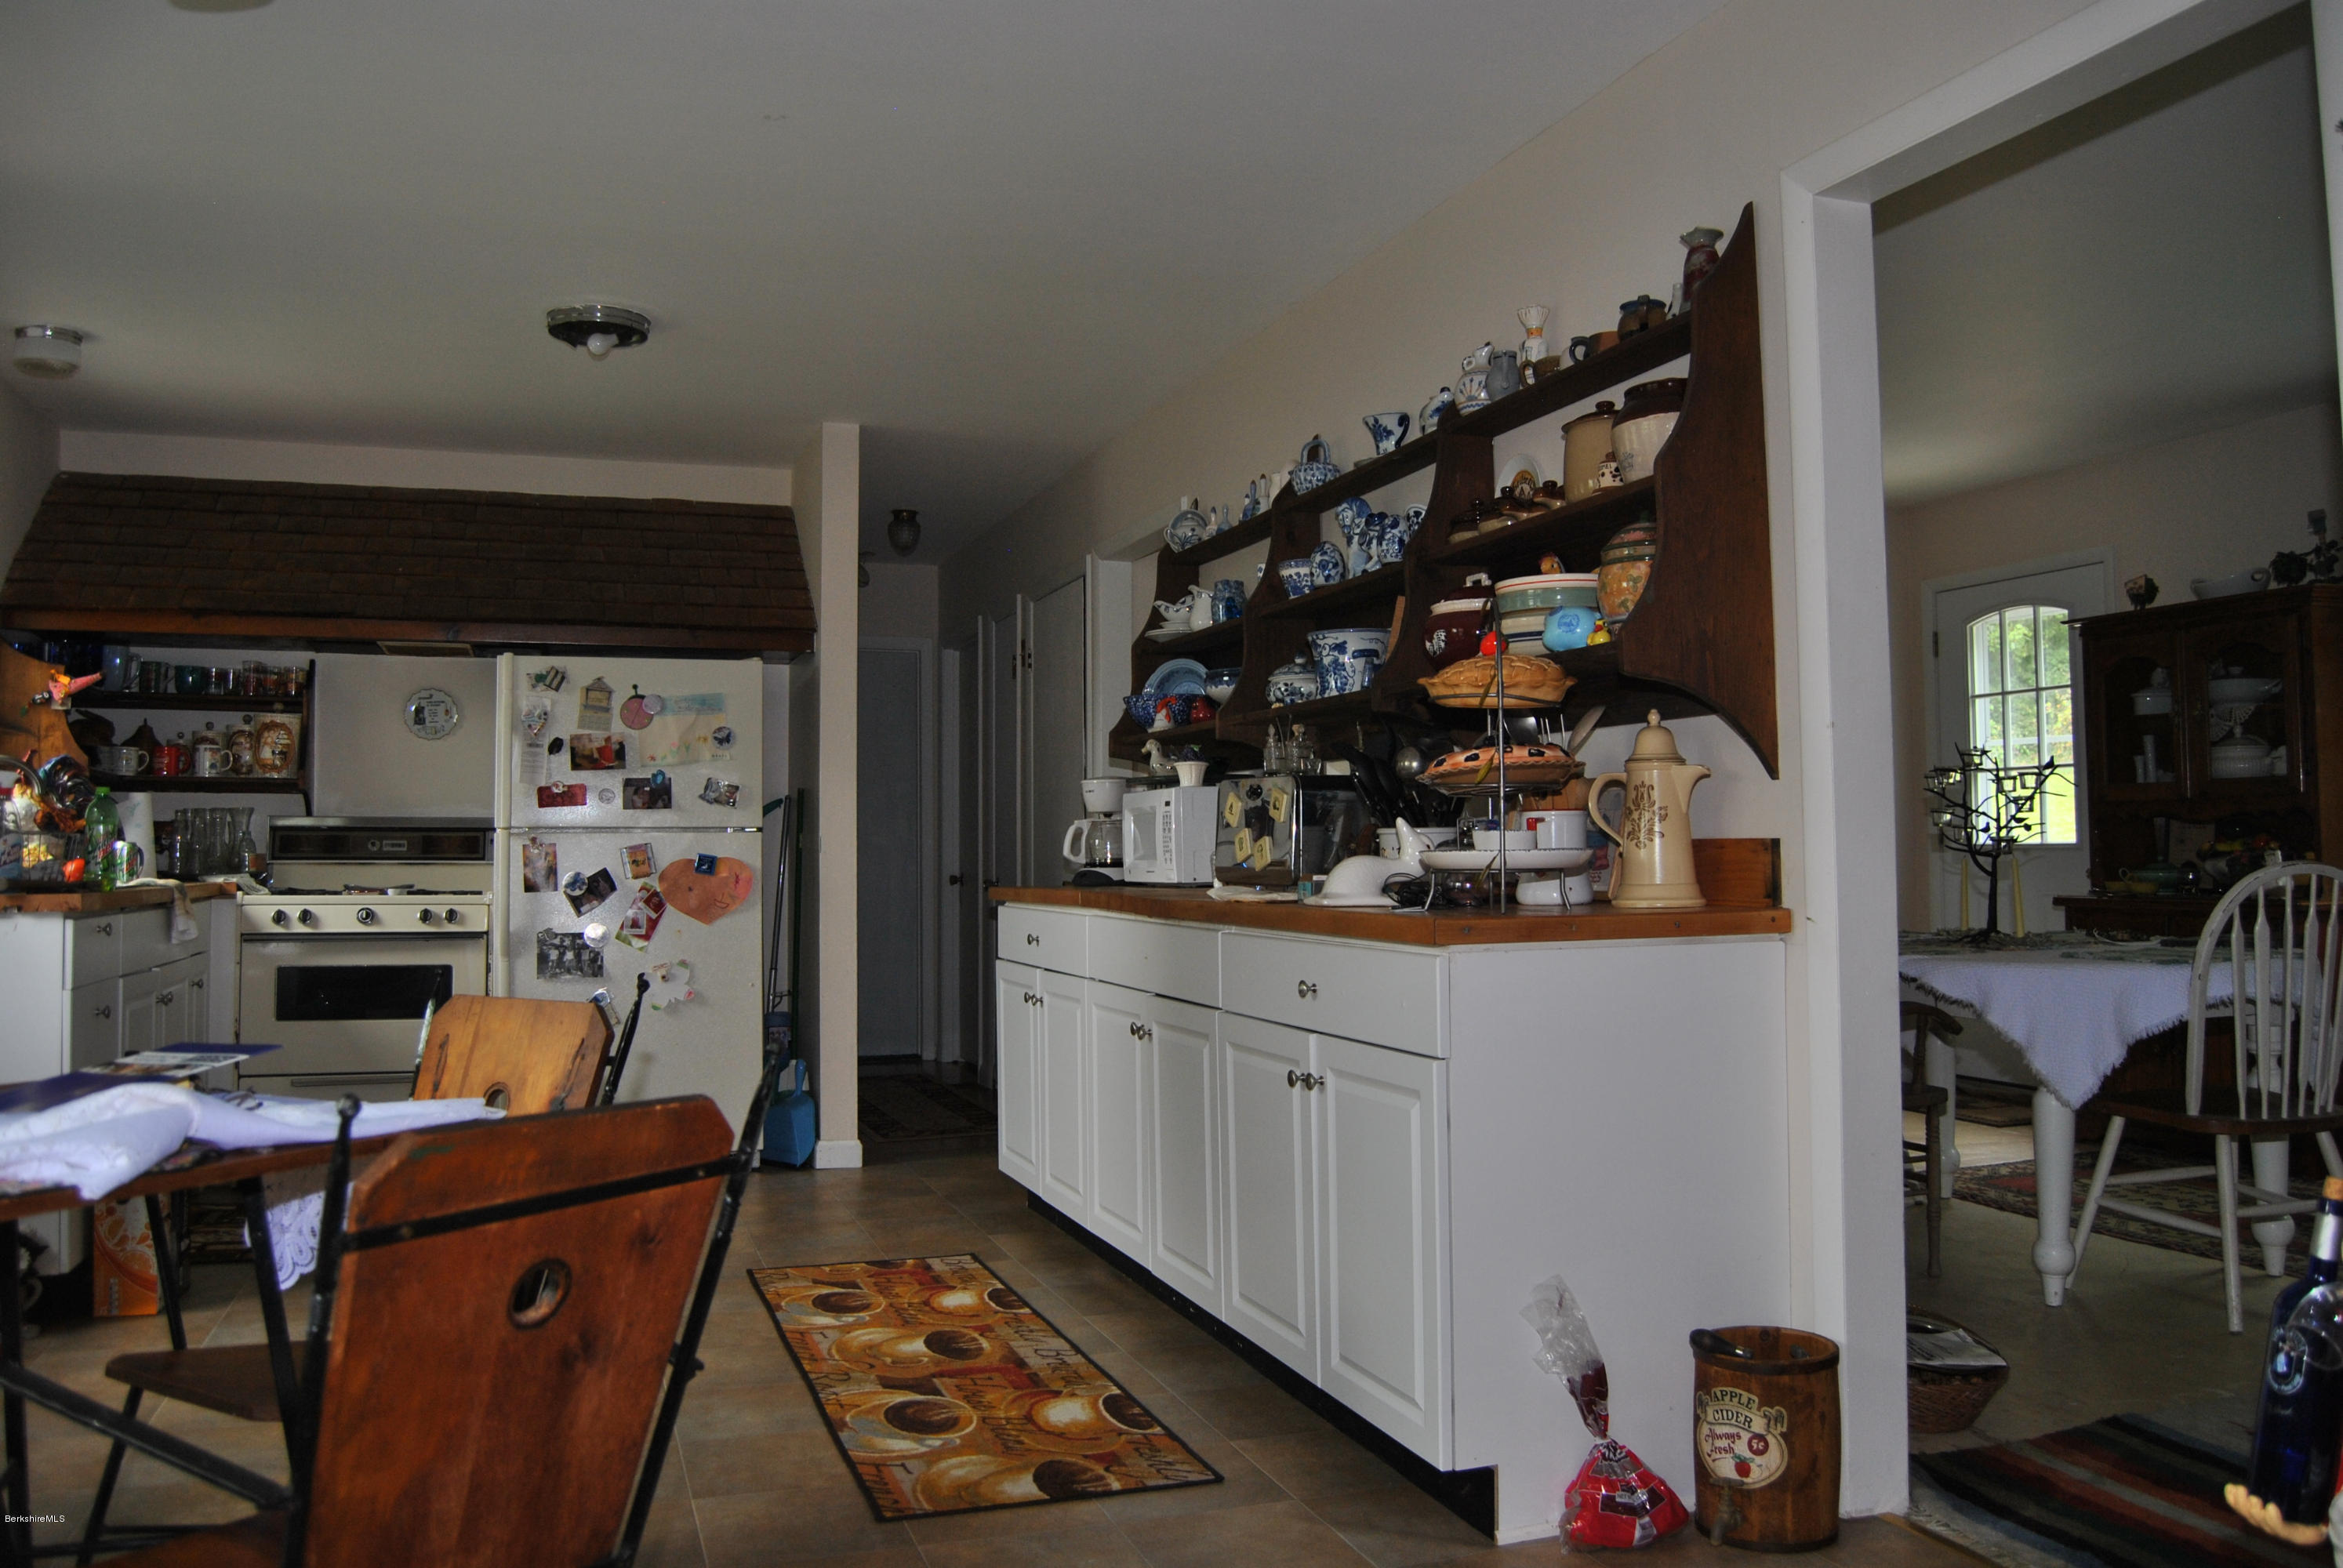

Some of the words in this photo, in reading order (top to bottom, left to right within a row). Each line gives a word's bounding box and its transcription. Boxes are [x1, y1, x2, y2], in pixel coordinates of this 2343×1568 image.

[1712, 1388, 1756, 1410] APPLE
[1713, 1408, 1753, 1429] CIDER
[1705, 1427, 1742, 1445] Always
[1707, 1440, 1735, 1457] Fresh
